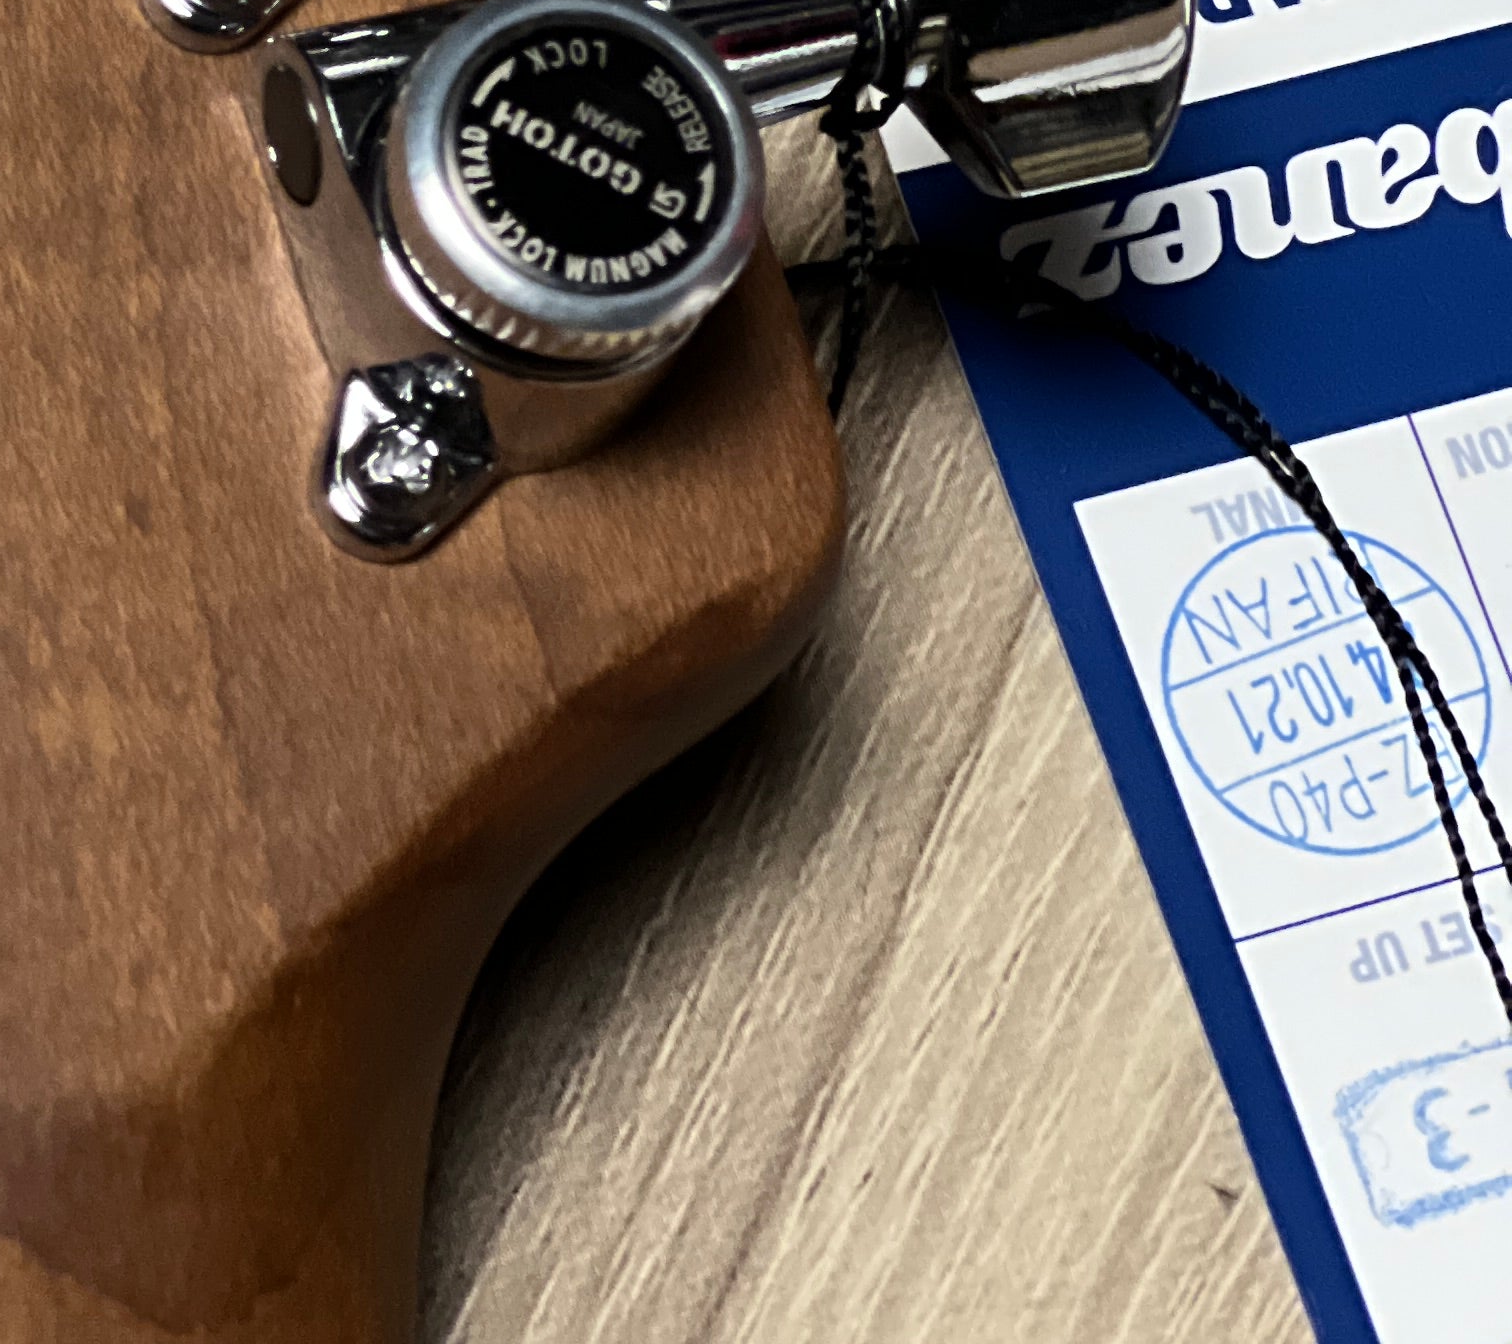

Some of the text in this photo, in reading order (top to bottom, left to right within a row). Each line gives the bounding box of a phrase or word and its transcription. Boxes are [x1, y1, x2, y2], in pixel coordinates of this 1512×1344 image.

[524, 38, 610, 74] LOCK
[571, 100, 645, 150] JAPAN
[640, 64, 713, 154] RELEASE
[489, 100, 644, 196] GOTOH
[460, 125, 688, 284] MAGNUM LOCK TRAD
[1445, 420, 1512, 479] ON
[1349, 930, 1410, 983] UP
